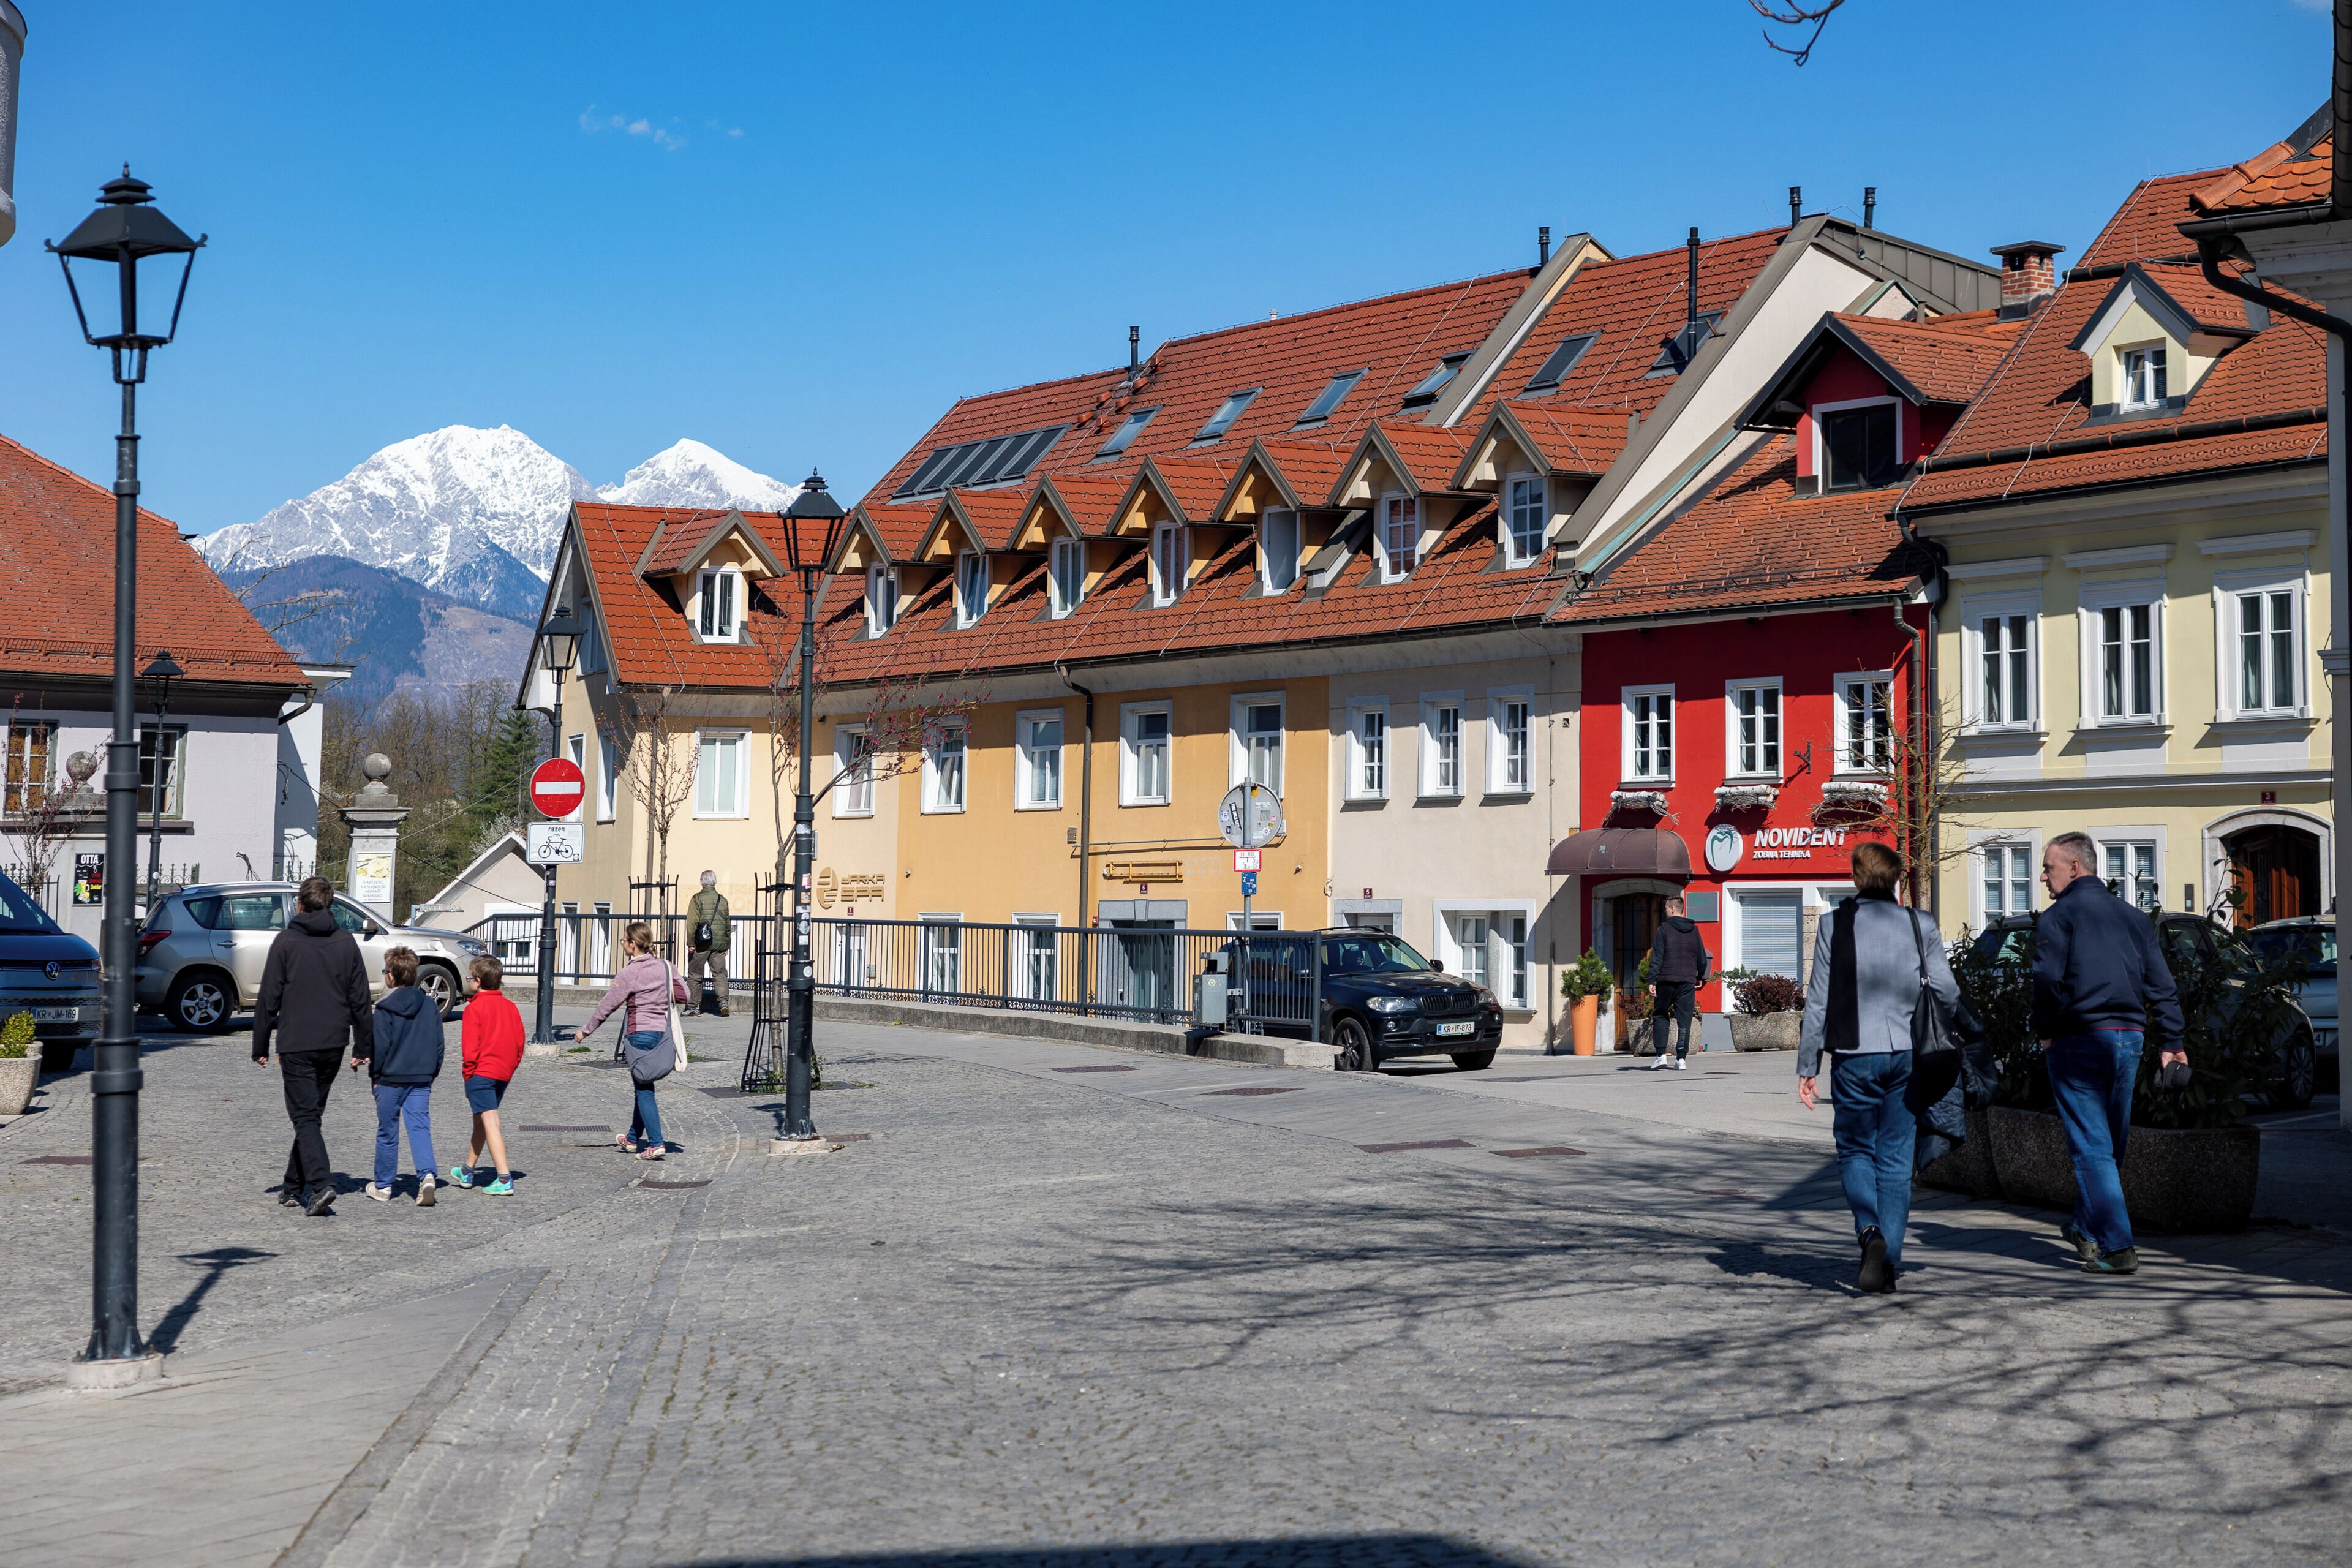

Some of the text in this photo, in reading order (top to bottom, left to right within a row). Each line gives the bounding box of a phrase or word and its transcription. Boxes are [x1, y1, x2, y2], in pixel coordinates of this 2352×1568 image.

[1754, 827, 1849, 846] NOVIDENT
[80, 854, 99, 864] OTTA
[841, 886, 884, 902] SPA
[37, 1009, 77, 1019] KR JM-169
